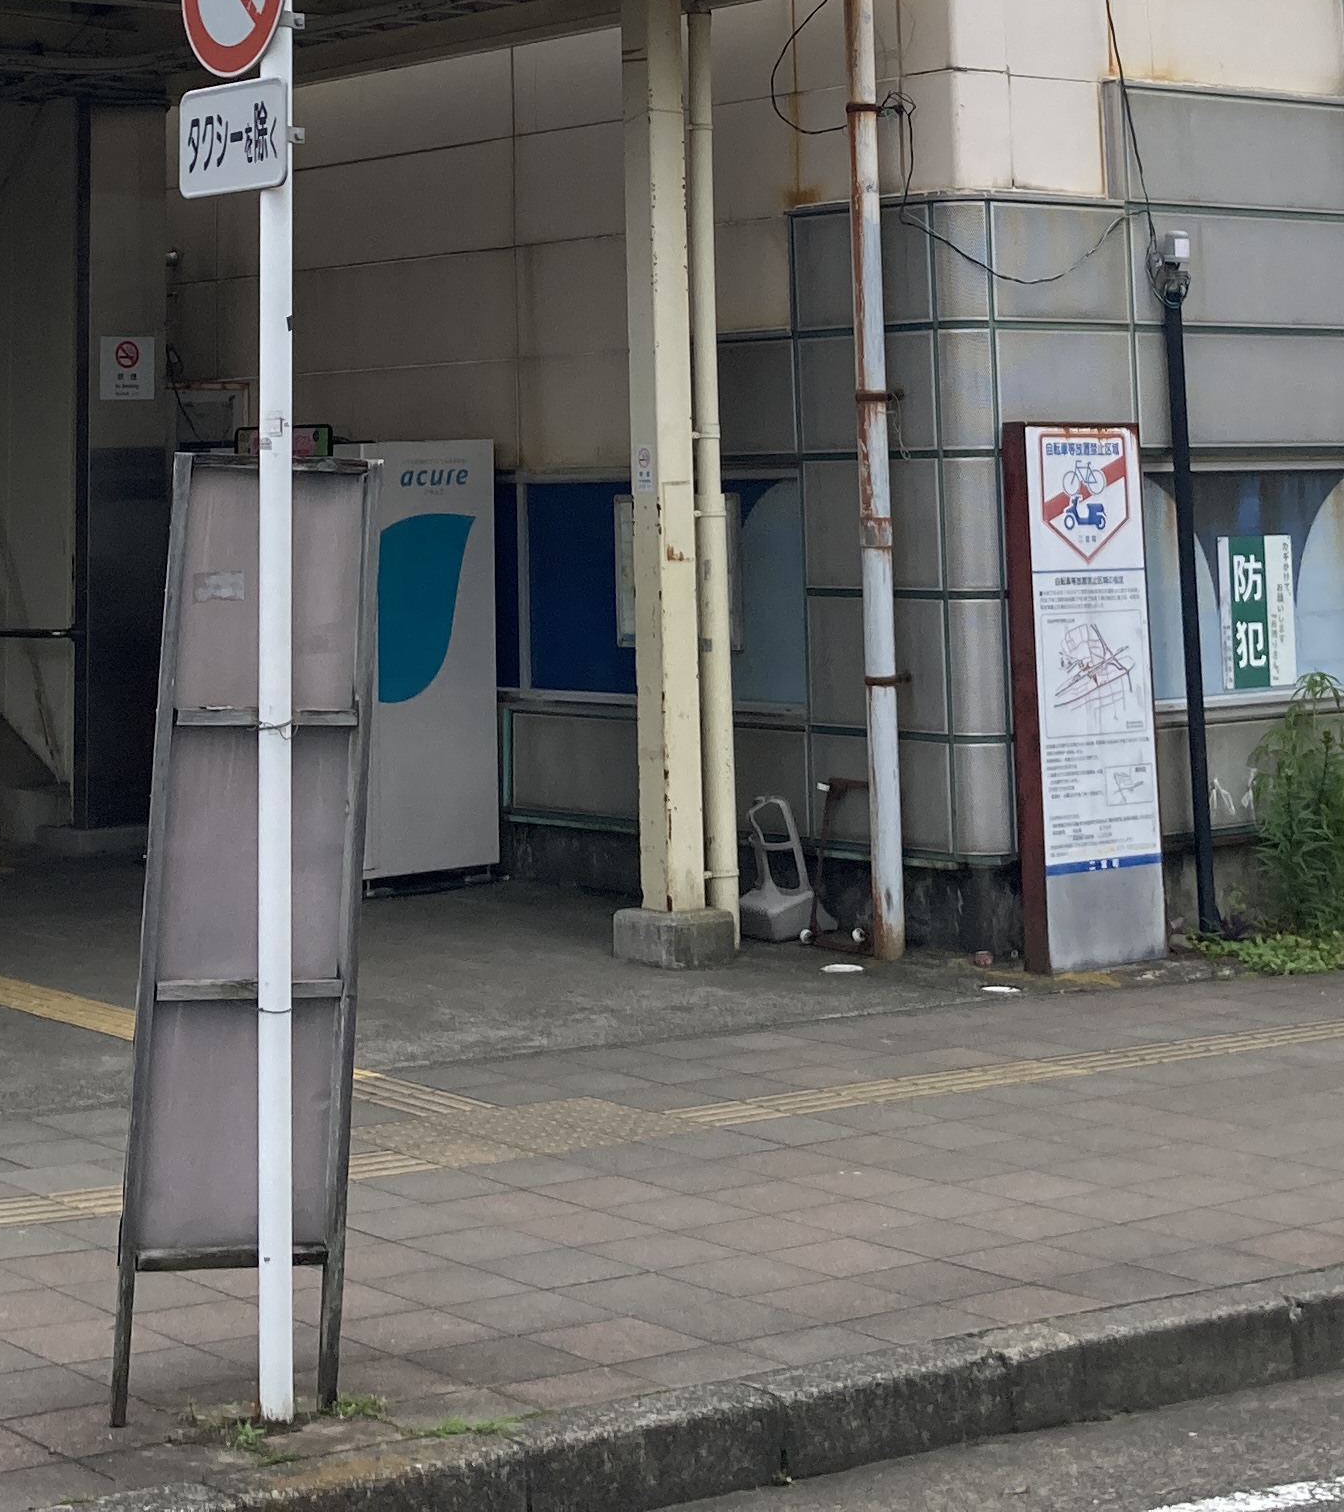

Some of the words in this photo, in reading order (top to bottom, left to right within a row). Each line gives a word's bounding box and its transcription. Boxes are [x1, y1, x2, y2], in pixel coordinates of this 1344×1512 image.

[187, 101, 278, 174] タクシーを除く
[400, 468, 469, 487] acure
[1232, 554, 1267, 669] 防犯
